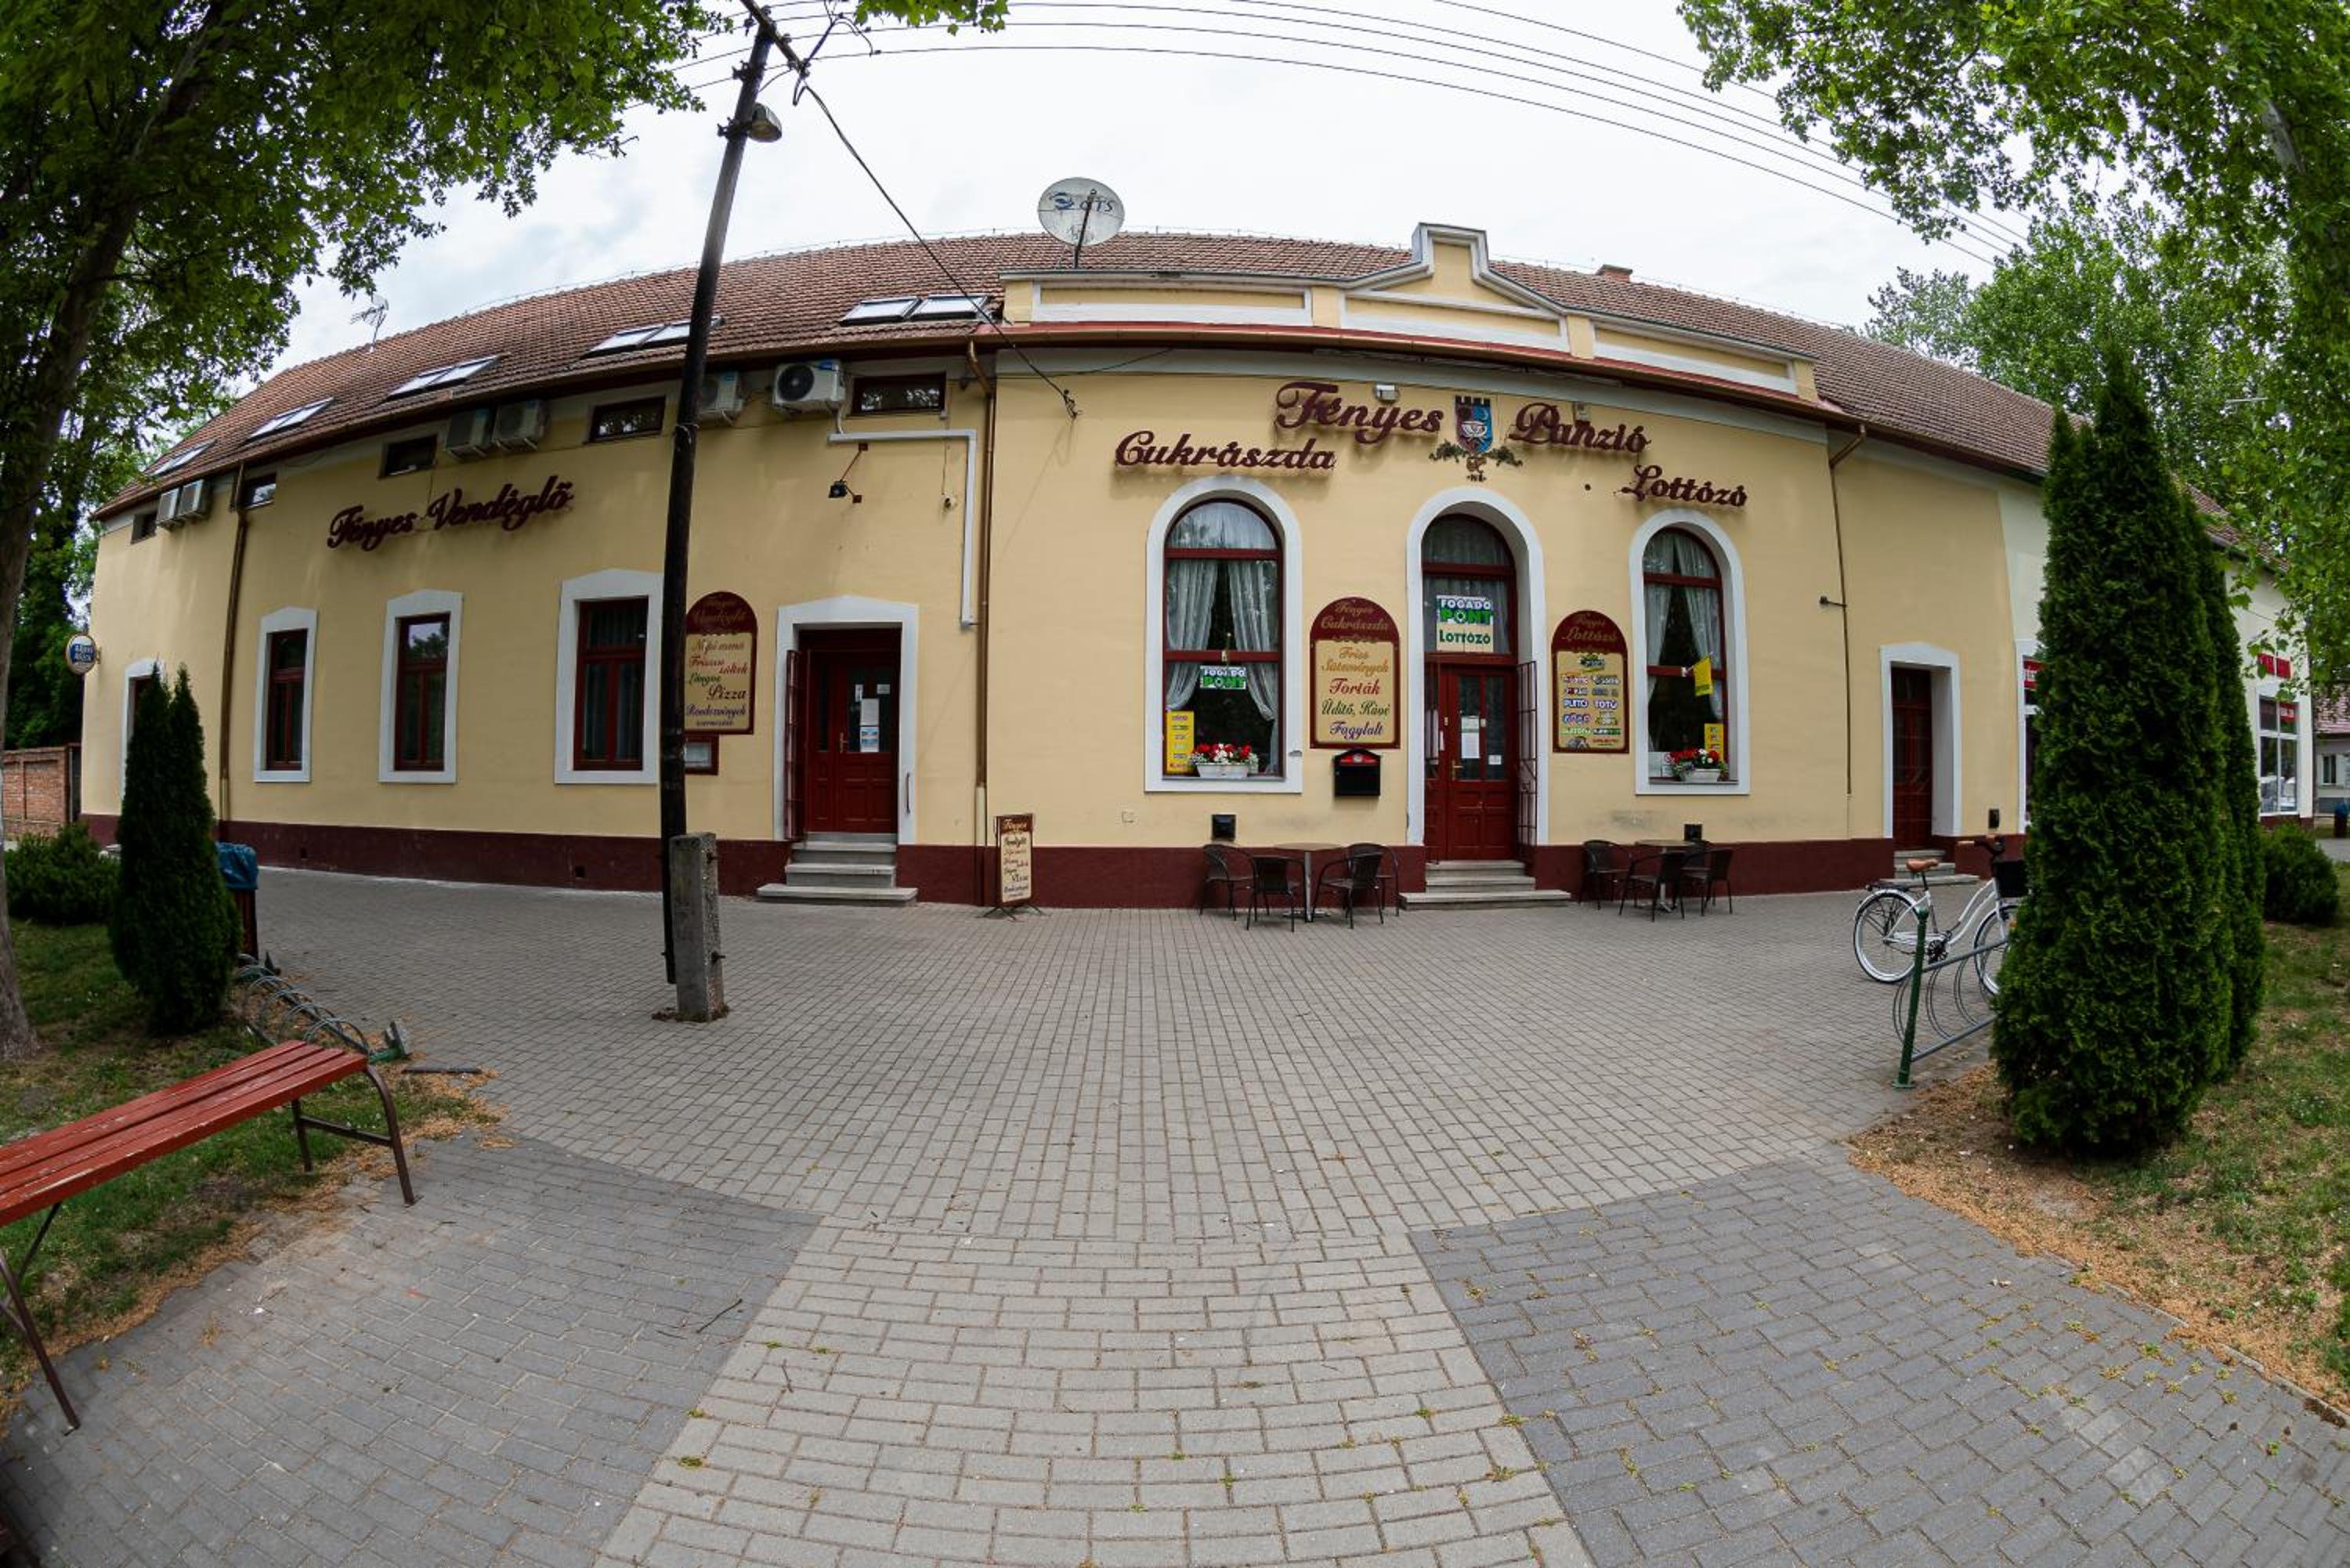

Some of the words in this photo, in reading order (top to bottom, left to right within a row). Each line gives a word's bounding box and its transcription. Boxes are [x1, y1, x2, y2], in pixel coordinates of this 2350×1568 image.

[1276, 381, 1444, 444] Fényes
[1506, 402, 1652, 453] Panzió
[1115, 430, 1336, 470] Cukrászda
[1618, 464, 1748, 507] Lottózó
[327, 505, 418, 551] Fényes
[427, 475, 575, 531] Vendéglő
[1440, 608, 1491, 625] PONT
[1339, 646, 1369, 659] Friss
[707, 685, 747, 700] Pizza
[1329, 677, 1380, 695] Torták
[1359, 699, 1390, 717] Kávé
[1329, 720, 1383, 740] Fagylalt
